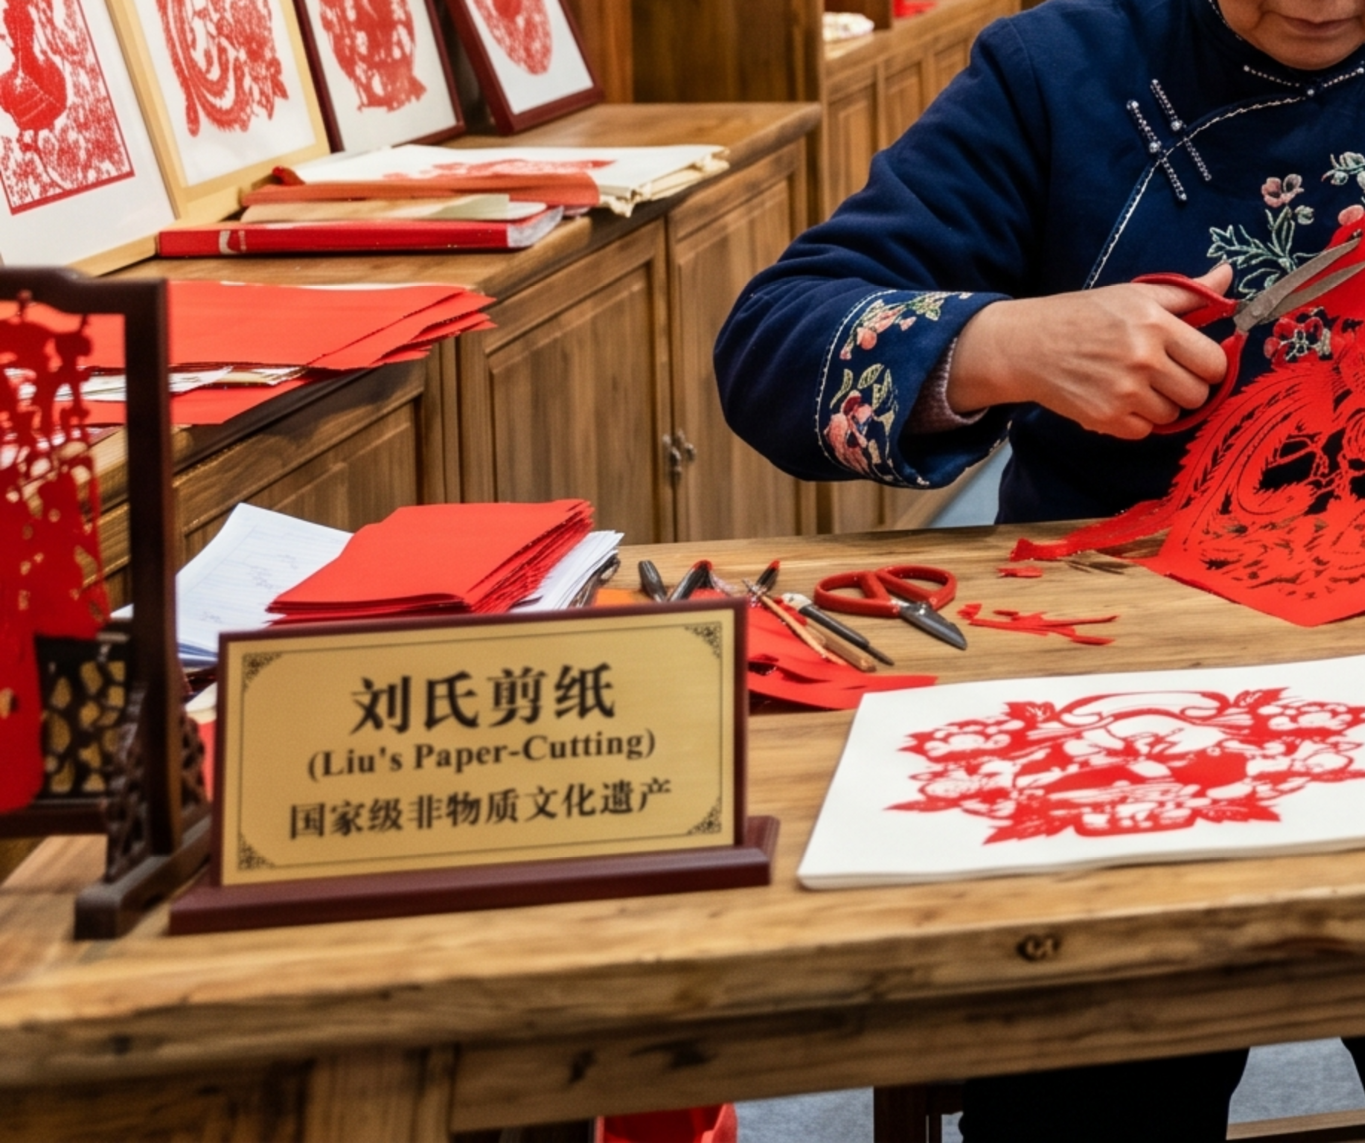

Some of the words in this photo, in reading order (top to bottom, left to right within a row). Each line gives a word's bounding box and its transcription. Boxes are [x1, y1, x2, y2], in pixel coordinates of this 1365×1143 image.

[350, 661, 617, 736] 刘氏剪纸
[307, 745, 404, 783] (Liu's
[412, 727, 656, 774] Paper-Cutting)
[288, 775, 673, 841] 国家级非物质文化遗产
